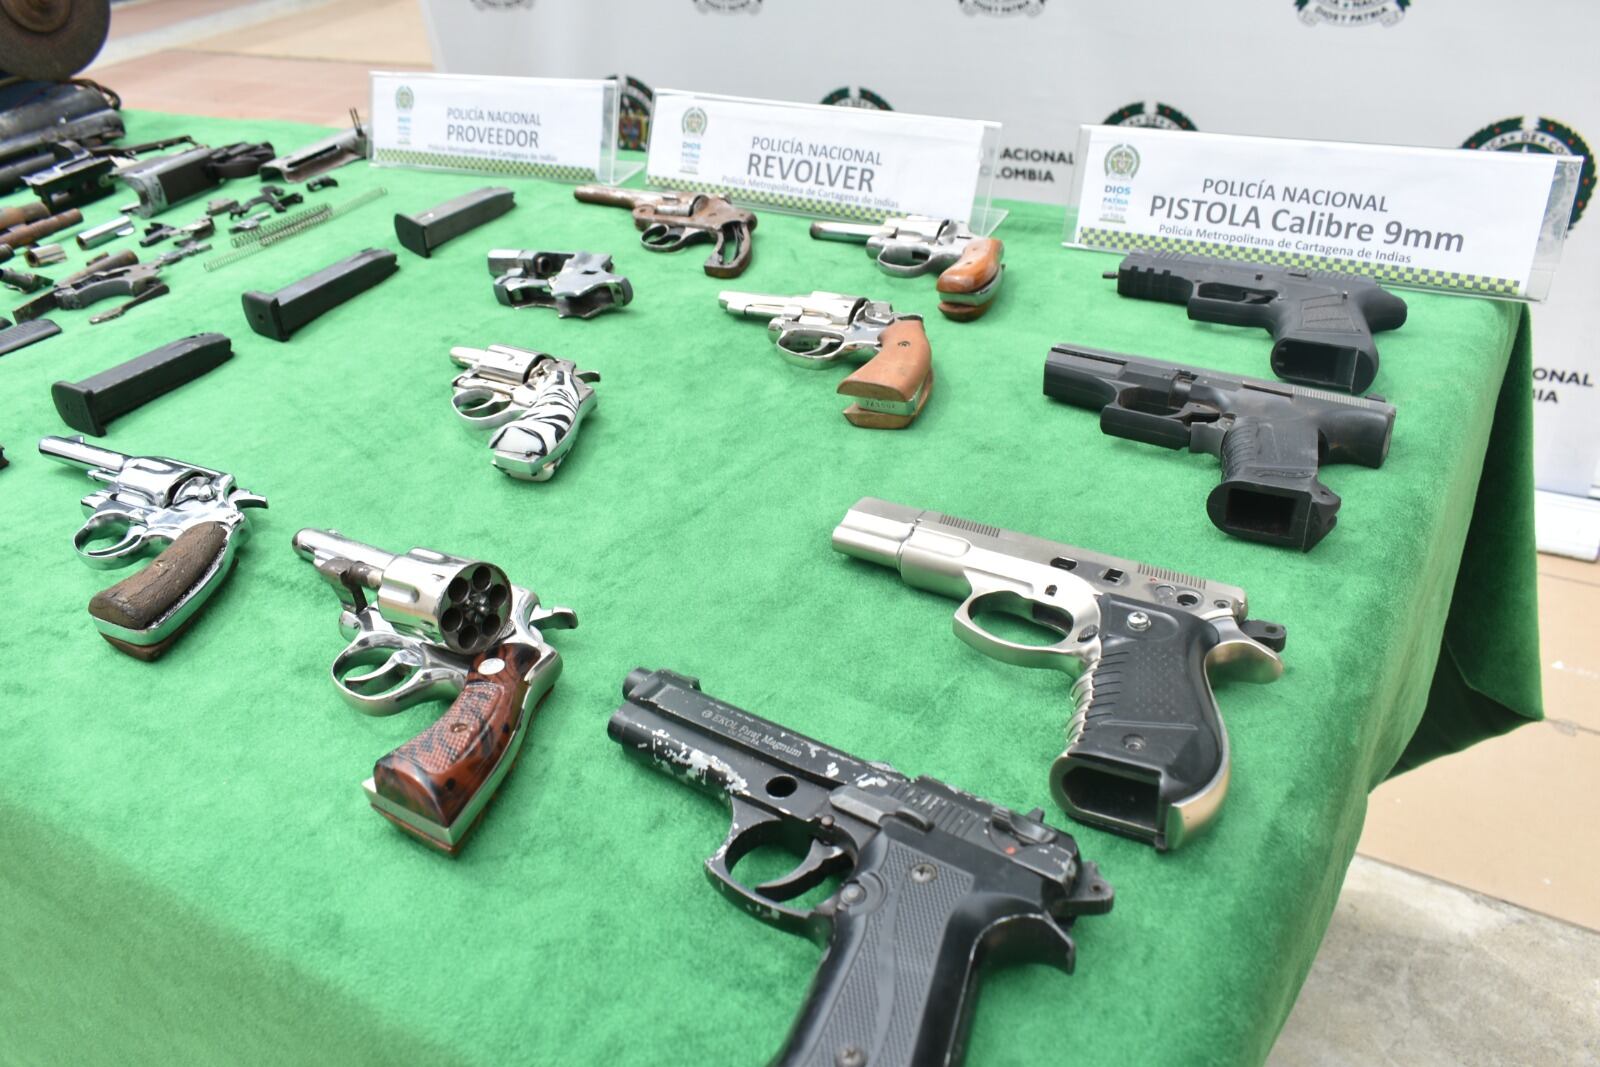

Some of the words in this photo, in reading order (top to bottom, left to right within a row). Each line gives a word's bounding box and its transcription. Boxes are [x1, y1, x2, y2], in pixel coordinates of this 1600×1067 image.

[446, 107, 485, 122] POLICÍA
[487, 110, 541, 126] NACIONAL
[446, 124, 539, 149] PROVEEDOR
[751, 136, 804, 155] POLICÍA
[807, 143, 883, 166] NACIONAL
[747, 153, 875, 193] REVOLVER
[1104, 184, 1131, 195] DIOS
[1202, 178, 1276, 201] POLICÍA
[1282, 186, 1389, 213] NACIONAL
[1149, 194, 1261, 229] PISTOLA
[1271, 208, 1374, 242] Calibre
[1383, 220, 1464, 253] 9mm
[1158, 223, 1192, 237] Policía
[1195, 228, 1275, 248] Metropolitana
[1277, 237, 1292, 249] de
[1295, 240, 1354, 257] Cartagena
[1357, 247, 1372, 259] de
[1375, 250, 1411, 264] Indias
[761, 734, 802, 757] Magnum
